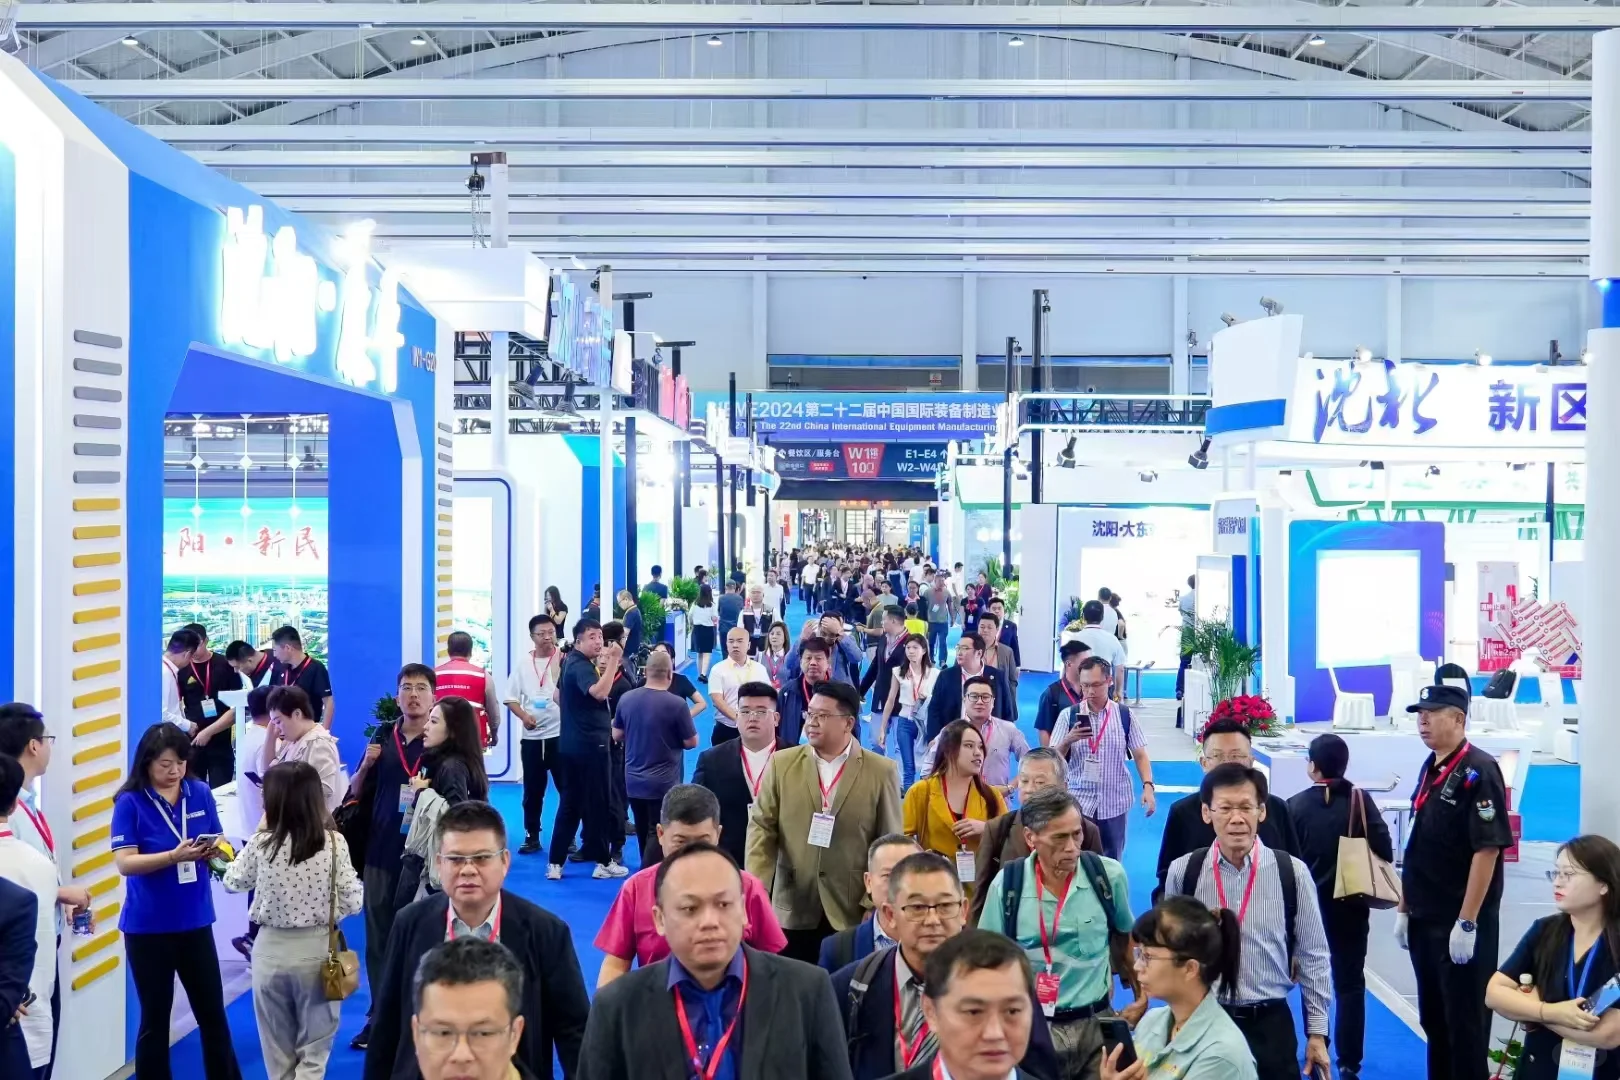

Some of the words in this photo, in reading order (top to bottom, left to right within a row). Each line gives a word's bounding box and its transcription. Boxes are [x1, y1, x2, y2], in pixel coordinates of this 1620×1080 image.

[1488, 380, 1587, 431] 新区
[761, 421, 777, 430] The
[780, 421, 801, 430] 22nd
[804, 421, 829, 430] China
[832, 421, 887, 431] International
[889, 422, 936, 432] Equipment
[938, 422, 996, 431] Manufacturin
[905, 449, 937, 458] E1-E4
[897, 462, 937, 472] W2-W4
[164, 526, 320, 560] 阳·新民
